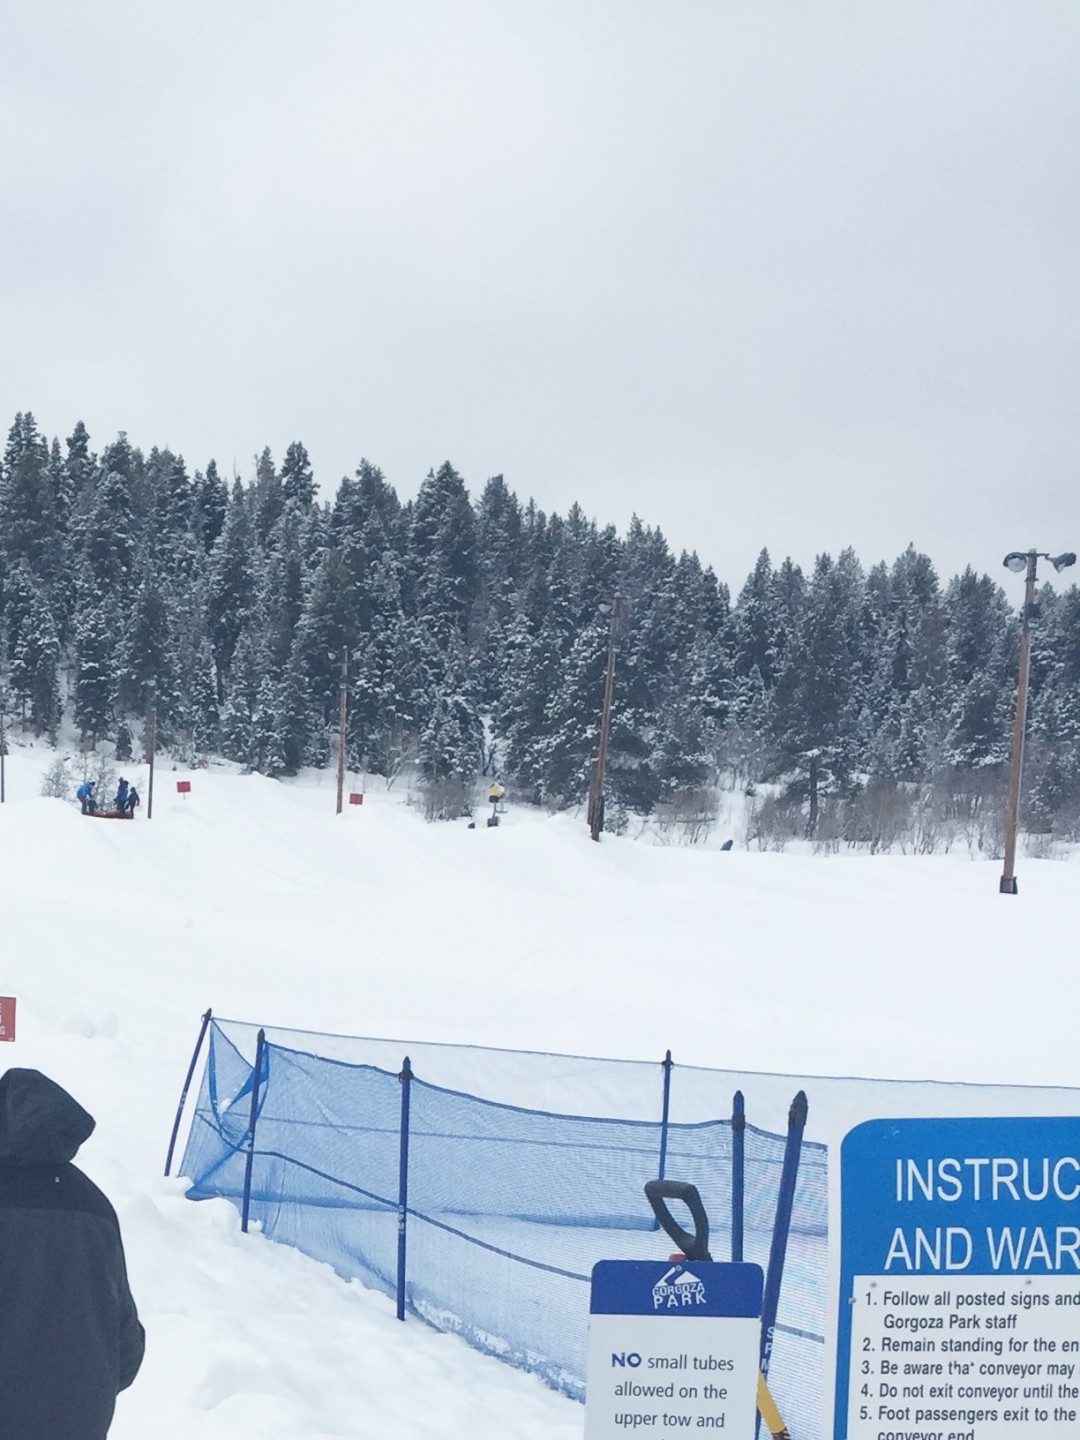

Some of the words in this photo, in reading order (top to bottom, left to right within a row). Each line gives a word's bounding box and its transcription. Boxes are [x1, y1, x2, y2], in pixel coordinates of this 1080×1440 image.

[897, 1157, 1080, 1201] INSTRUC
[884, 1227, 972, 1270] AND
[987, 1227, 1080, 1270] WAR
[652, 1283, 705, 1297] GORGOZA
[654, 1291, 706, 1309] PARK
[866, 1292, 877, 1305] 1.
[884, 1291, 929, 1305] Follow
[934, 1291, 950, 1305] all
[956, 1291, 1005, 1309] posted
[1011, 1291, 1049, 1309] signs
[1055, 1291, 1080, 1305] and
[884, 1314, 943, 1332] Gorgoza
[950, 1314, 980, 1328] Park
[986, 1314, 1017, 1329] staff
[863, 1337, 875, 1351] 2.
[882, 1337, 935, 1351] Remain
[941, 1338, 1003, 1356] standing
[1009, 1338, 1028, 1352] for
[1034, 1338, 1056, 1352] the
[1062, 1341, 1079, 1352] en
[612, 1353, 641, 1367] NO
[648, 1354, 687, 1369] small
[693, 1355, 734, 1371] tubes
[862, 1360, 874, 1374] 3.
[881, 1360, 898, 1374] Be
[904, 1364, 943, 1375] aware
[979, 1364, 1042, 1379] conveyor
[1047, 1364, 1075, 1379] may
[615, 1381, 673, 1397] allowed
[679, 1387, 697, 1398] on
[704, 1384, 727, 1399] the
[861, 1384, 873, 1397] 4.
[880, 1383, 897, 1397] Do
[903, 1385, 923, 1397] not
[930, 1384, 953, 1398] exit
[958, 1387, 1019, 1402] conveyor
[1024, 1384, 1053, 1398] until
[1058, 1384, 1079, 1398] the
[615, 1413, 657, 1428] upper
[663, 1413, 691, 1426] tow
[697, 1413, 725, 1427] and
[860, 1406, 872, 1420] 5.
[879, 1406, 910, 1420] Foot
[916, 1410, 998, 1424] passengers
[1004, 1407, 1029, 1421] exit
[1035, 1408, 1048, 1421] to
[1054, 1407, 1076, 1421] the
